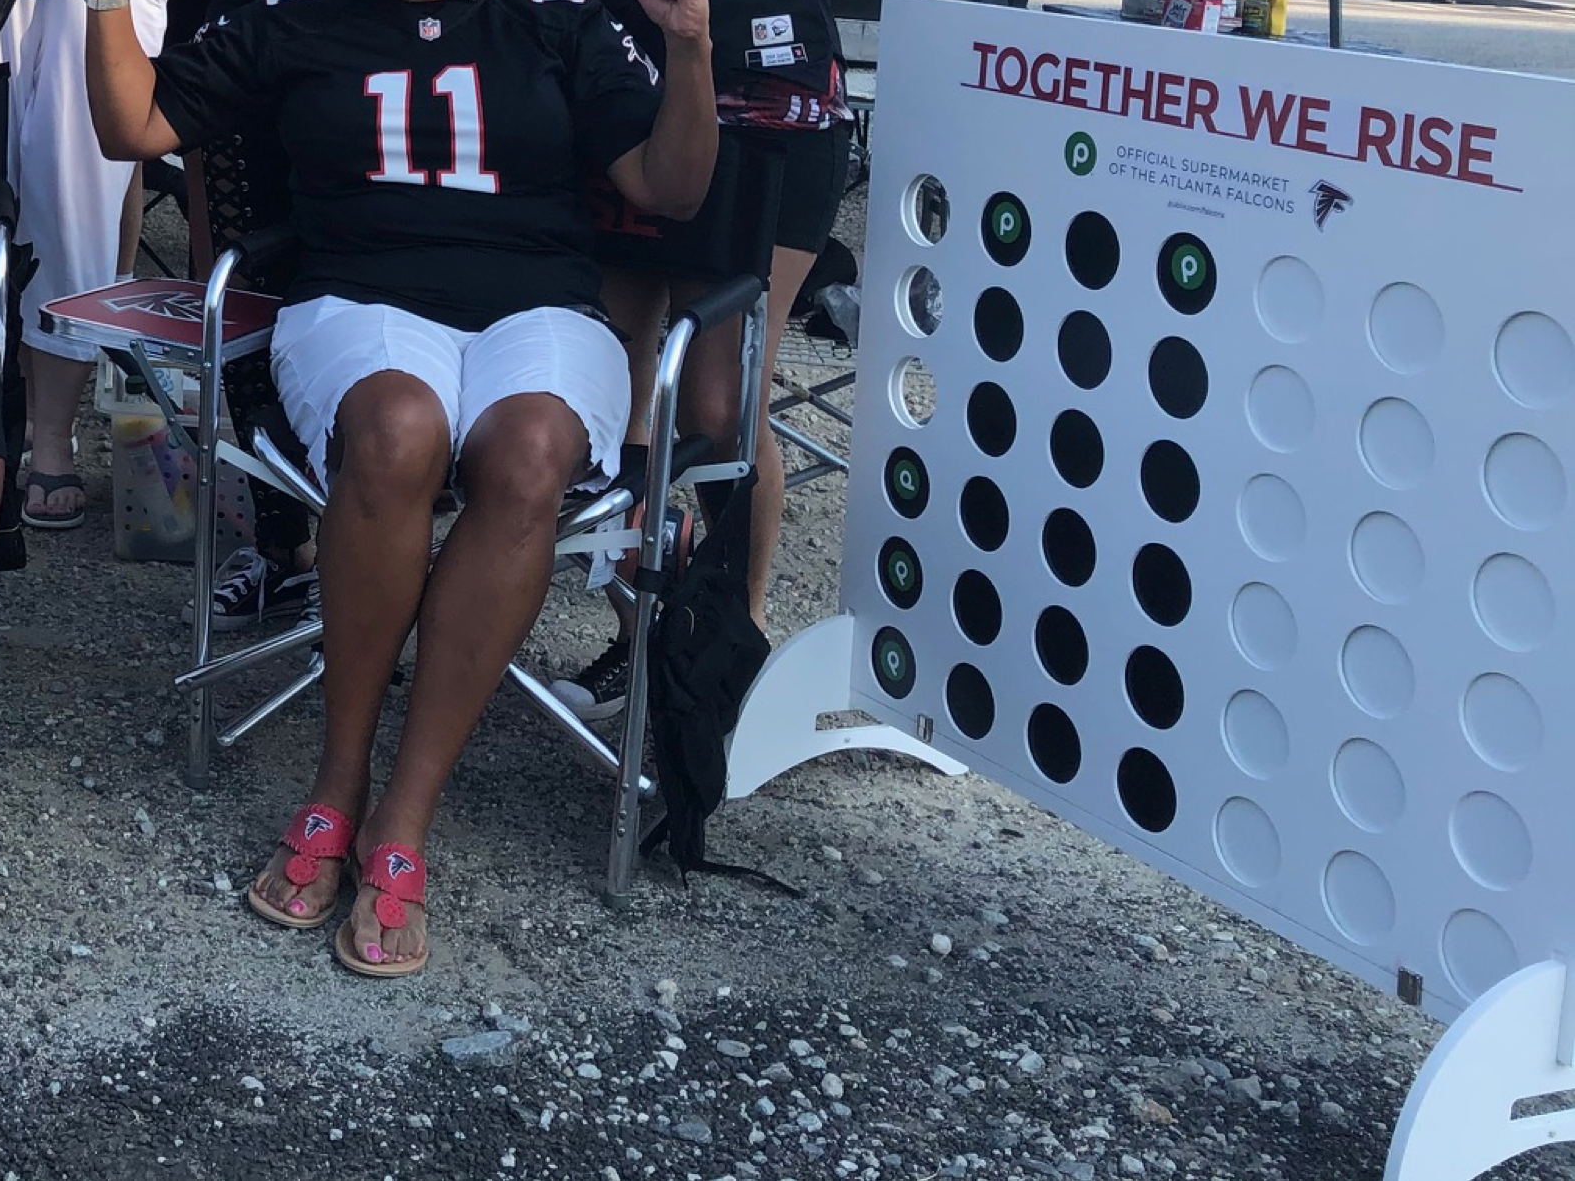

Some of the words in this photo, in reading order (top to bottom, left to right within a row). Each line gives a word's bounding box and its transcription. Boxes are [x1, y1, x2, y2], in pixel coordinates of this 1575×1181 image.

[363, 62, 501, 195] 11
[972, 40, 1220, 133] TOGETHER
[1238, 84, 1331, 153] WE
[1357, 105, 1498, 185] RISE
[1108, 162, 1127, 175] OF
[1131, 165, 1156, 184] THE
[1159, 173, 1222, 198] ATLANTA
[1225, 186, 1295, 214] FALCONS
[1116, 145, 1176, 170] OFFICIAL
[1181, 157, 1290, 193] SUPERMARKET
